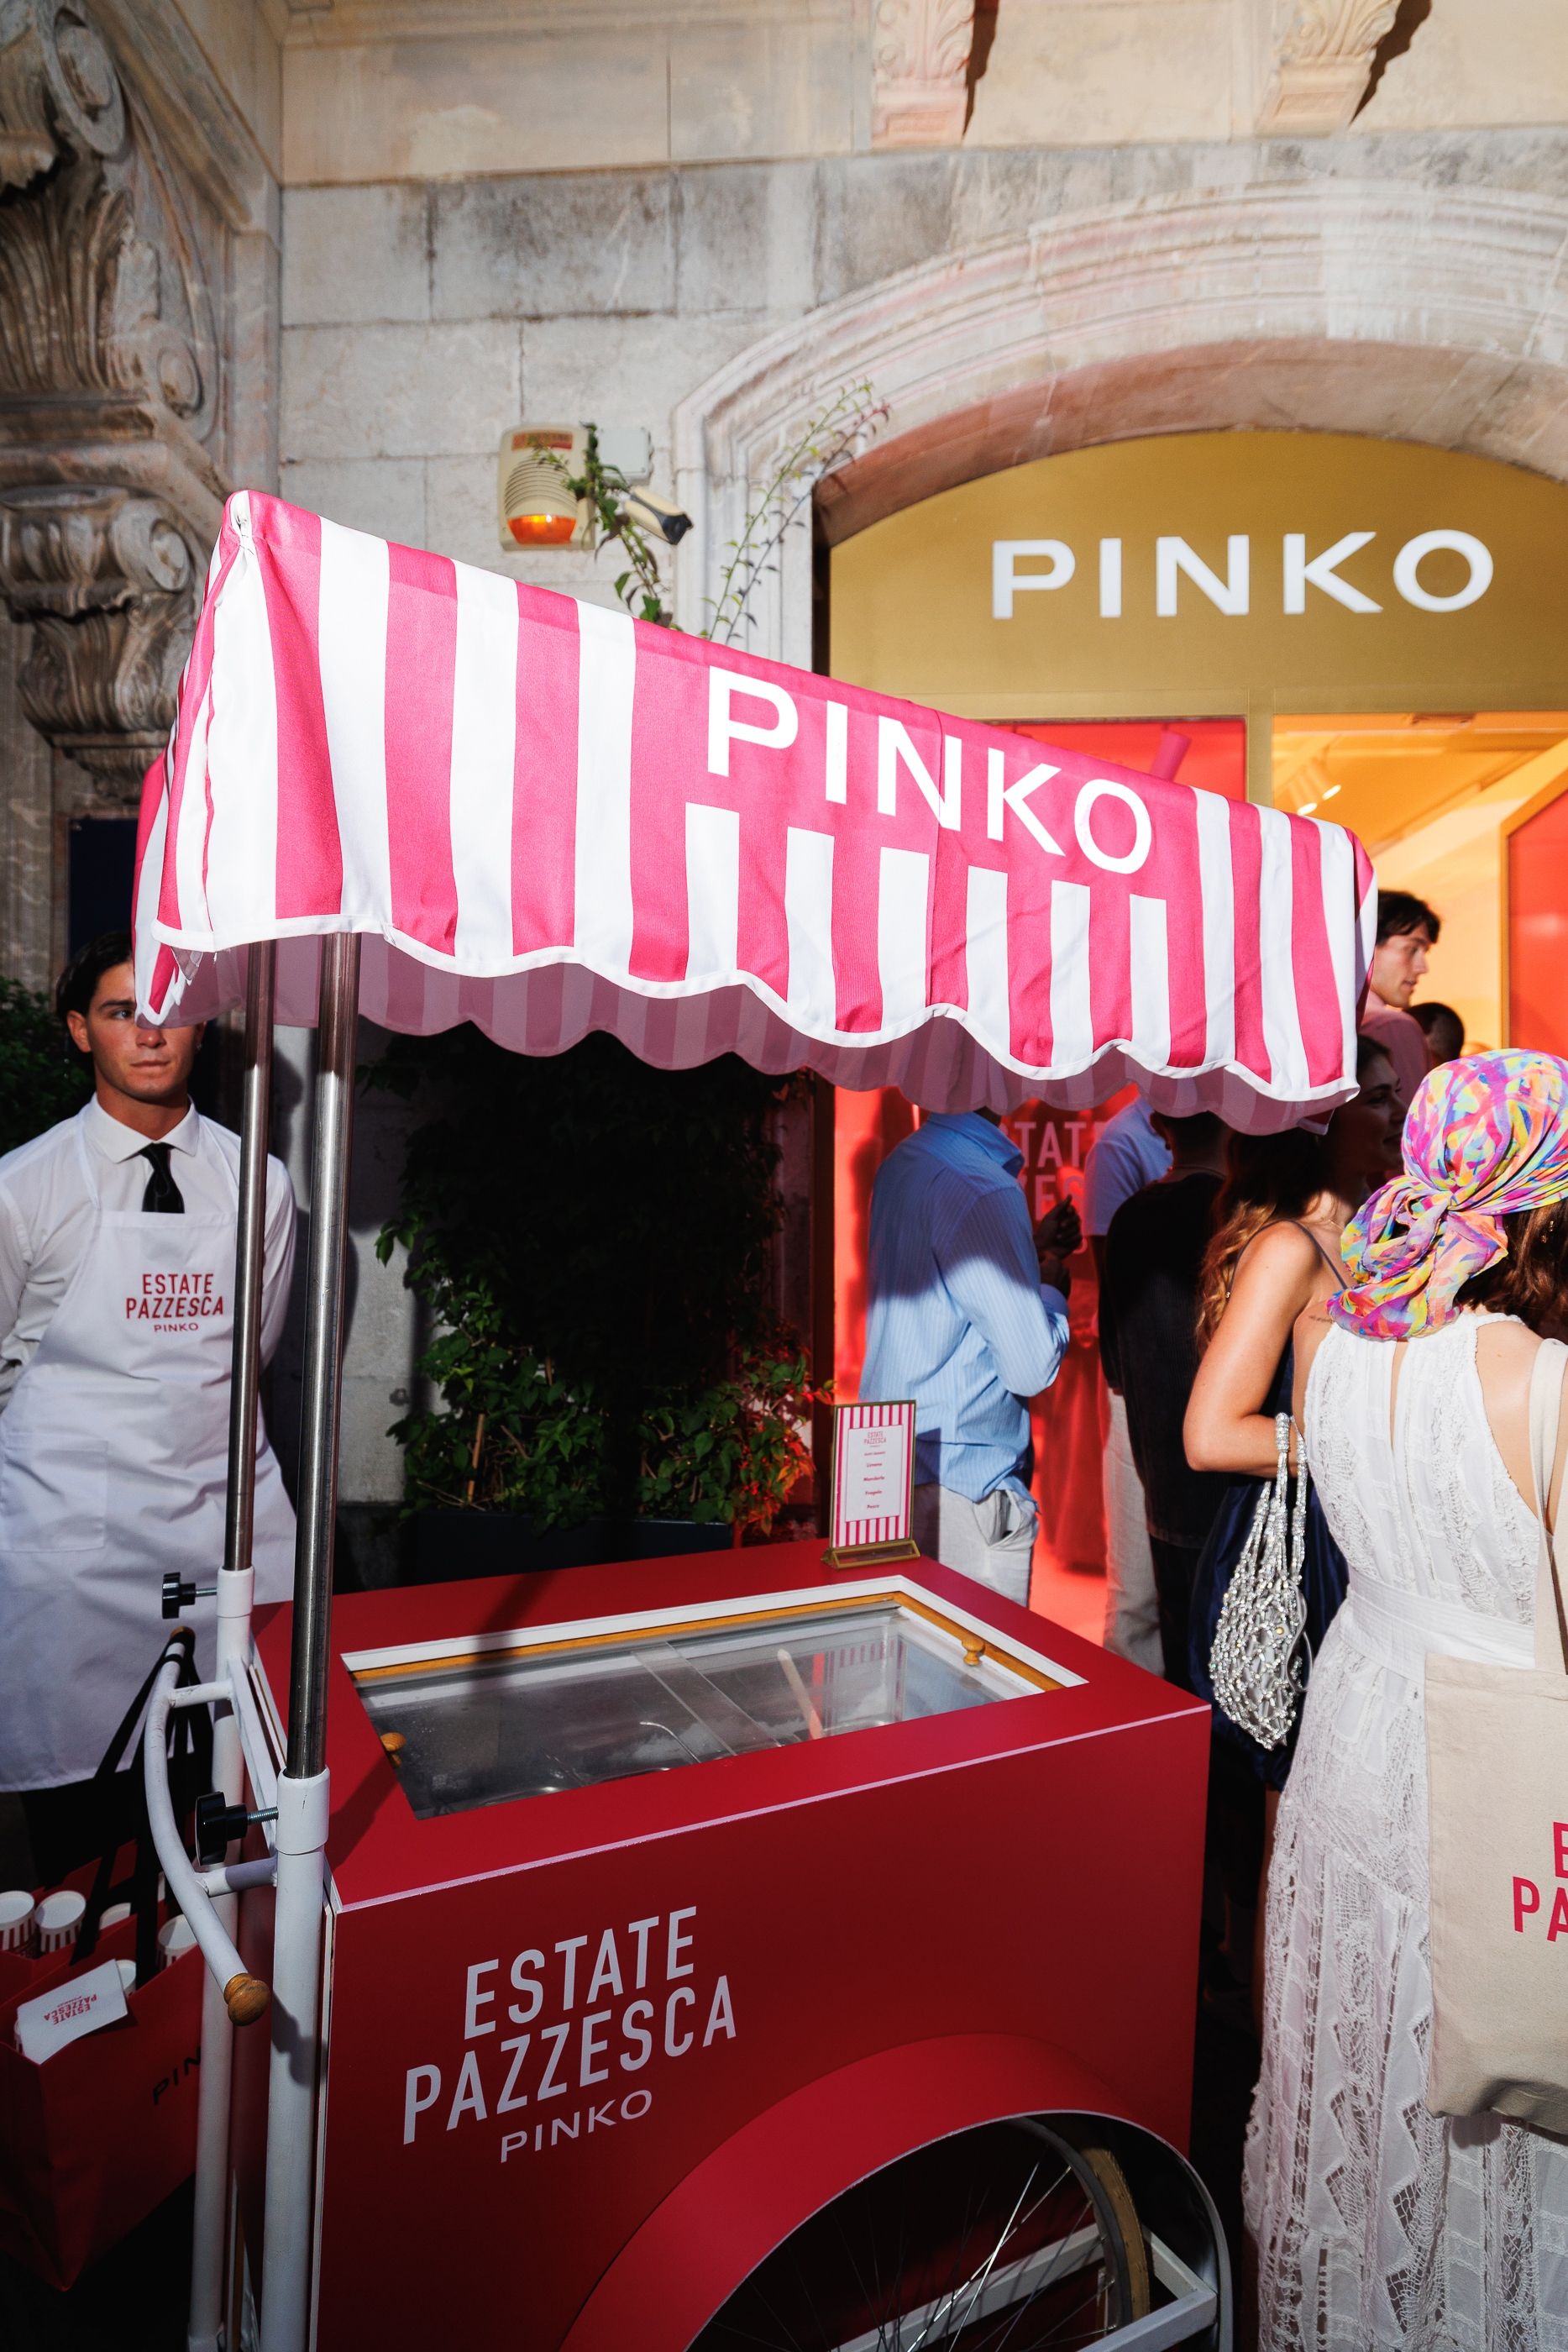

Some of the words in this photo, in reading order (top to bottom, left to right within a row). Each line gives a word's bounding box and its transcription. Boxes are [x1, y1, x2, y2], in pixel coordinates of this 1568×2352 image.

[992, 528, 1494, 619] PINKO
[707, 664, 1152, 874] PINKO
[999, 1121, 1107, 1168] TAT
[142, 1273, 214, 1294] ESTATE
[125, 1295, 224, 1320] PAZZESCA
[153, 1322, 200, 1332] PINKO
[464, 1906, 697, 2040] ESTATE
[44, 1993, 97, 2021] PAZZESCA
[53, 2003, 91, 2025] ESTATE
[403, 1975, 737, 2145] PAZZESCA
[501, 2089, 653, 2163] PINKO
